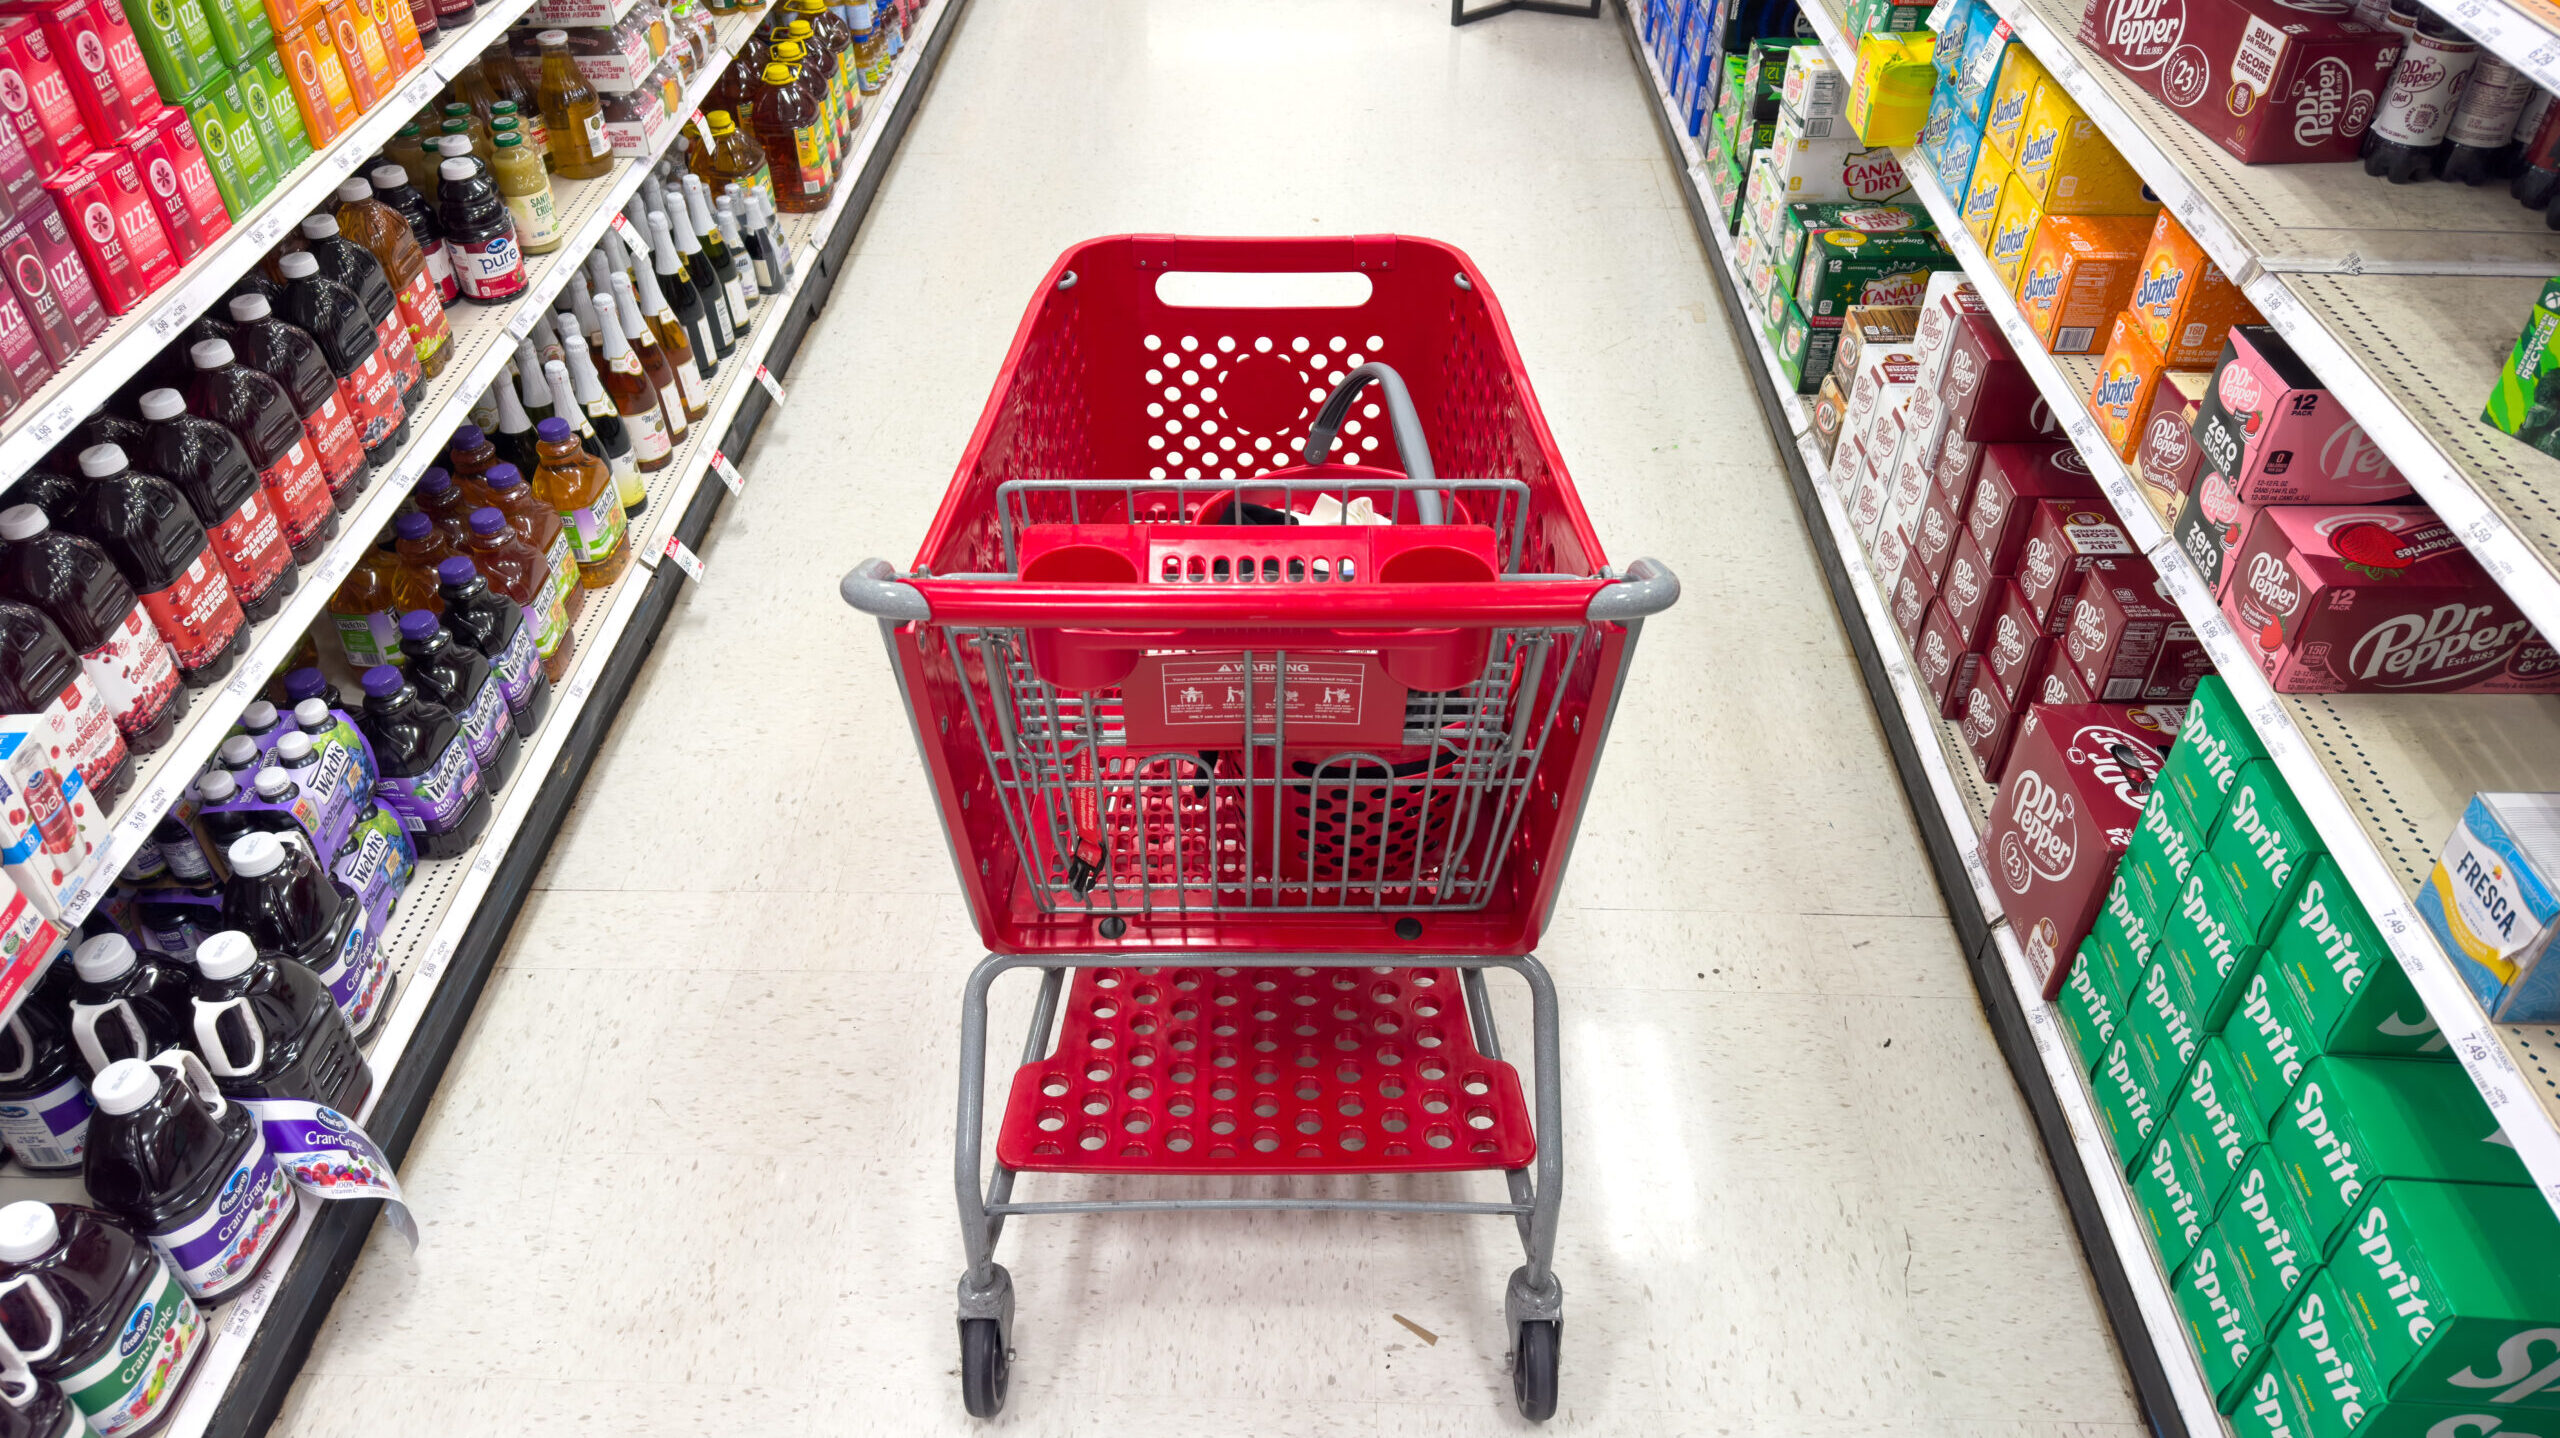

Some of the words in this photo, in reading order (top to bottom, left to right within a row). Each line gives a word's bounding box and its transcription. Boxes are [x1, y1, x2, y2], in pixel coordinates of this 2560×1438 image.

[2457, 1, 2480, 18] 6.29
[1936, 22, 1967, 56] Sunkist
[2108, 0, 2179, 56] Pepper
[2254, 27, 2275, 45] BUY
[110, 34, 141, 72] IZZE
[2246, 34, 2254, 44] DR
[2254, 39, 2276, 57] PEPPER
[2375, 48, 2393, 71] 12
[2528, 48, 2554, 66] 6.29
[320, 54, 342, 83] IZZE
[2174, 60, 2195, 92] 23
[2236, 60, 2267, 84] REWARDS
[2240, 50, 2271, 75] SCORE
[32, 71, 69, 110] IZZE
[272, 86, 296, 119] IZZE
[2393, 93, 2407, 102] Diet
[1926, 108, 1953, 141] Sunkist
[1992, 91, 2027, 127] Sunkist
[2348, 106, 2367, 123] 23
[131, 128, 159, 151] STRAWBERRY
[231, 119, 256, 154] IZZE
[2021, 130, 2058, 166] Sunkist
[116, 161, 135, 179] FIZZY
[181, 156, 211, 195] IZZE
[1942, 144, 1971, 177] Sunkist
[64, 171, 97, 196] STRAWBERRY
[121, 170, 137, 185] FRUIT
[126, 177, 139, 192] JUICE
[1865, 173, 1902, 194] DRY
[165, 194, 184, 215] IZZE
[1968, 184, 1999, 215] Sunkist
[2180, 204, 2194, 217] 3.99
[43, 210, 60, 229] FIZZY
[120, 200, 155, 239] IZZE
[1842, 210, 1914, 226] CANADA
[1867, 218, 1900, 229] DRY
[101, 239, 123, 261] IZZE
[1994, 223, 2029, 257] Sunkist
[51, 250, 84, 292] IZZE
[477, 247, 518, 274] pure
[1829, 260, 1842, 269] 12
[2024, 269, 2062, 302] Sunkist
[2137, 267, 2183, 308] Sunkist
[34, 294, 56, 315] IZZE
[421, 294, 440, 319] WHITE
[2153, 306, 2172, 318] Orange
[2263, 293, 2281, 312] 3.99
[155, 320, 169, 336] 4.99
[391, 333, 411, 360] GRAPE
[2516, 333, 2537, 376] REFRESH
[2535, 313, 2550, 334] THEN
[2521, 316, 2559, 381] RECYCLE
[1961, 355, 1973, 371] Dr
[369, 375, 394, 406] GRAPE
[2096, 371, 2141, 408] Sunkist
[2220, 364, 2258, 402] Pepper
[2236, 371, 2253, 388] Dr
[2112, 406, 2129, 418] Orange
[2293, 394, 2318, 410] 12
[2151, 419, 2184, 457] Pepper
[2167, 421, 2180, 440] Dr
[2207, 415, 2237, 462] zero
[2152, 453, 2159, 467] &
[2203, 432, 2231, 478] SUGAR
[2276, 453, 2284, 464] 0
[397, 475, 410, 489] 3.19
[1985, 483, 1999, 502] Dr
[2110, 480, 2124, 498] 6.99
[2144, 465, 2162, 484] Cream
[2161, 474, 2176, 492] Soda
[1977, 479, 2001, 520] Pepper
[2166, 503, 2176, 517] 12
[2202, 475, 2236, 516] Pepper
[251, 529, 278, 560] BLEND
[2188, 521, 2217, 567] zero
[2468, 521, 2492, 543] 4.59
[2027, 538, 2056, 578] Pepper
[2036, 543, 2051, 561] Dr
[2161, 555, 2177, 572] 6.99
[2185, 538, 2211, 581] SUGAR
[2249, 552, 2296, 607] Pepper
[2269, 561, 2289, 584] Dr
[200, 590, 228, 624] BLEND
[2329, 589, 2356, 604] 12
[2008, 621, 2021, 638] Dr
[2075, 600, 2106, 645] Pepper
[2085, 611, 2103, 630] Dr
[2202, 620, 2218, 639] 6.99
[2243, 603, 2273, 626] Strawberries
[2423, 603, 2493, 641] Dr
[1999, 615, 2024, 656] Pepper
[2071, 639, 2081, 656] 23
[2360, 615, 2526, 680] Pepper
[503, 634, 530, 681] Welch's
[2264, 654, 2275, 675] 12
[2447, 651, 2495, 667] Est.1885
[2087, 668, 2096, 688] 12
[467, 687, 496, 737] Welch's
[1968, 688, 1995, 729] Pepper
[1978, 693, 1992, 711] Dr
[2254, 704, 2273, 727] 7.49
[2026, 709, 2038, 728] 24
[2183, 698, 2236, 795] Sprite
[315, 745, 345, 797] Welch's
[428, 745, 462, 800] Welch's
[30, 786, 63, 822] Diet
[2012, 770, 2070, 862] Pepper
[2039, 785, 2064, 830] Dr
[130, 811, 146, 829] 3.19
[2146, 790, 2190, 884] Sprite
[2232, 785, 2292, 889] Sprite
[354, 832, 384, 885] Welch's
[479, 860, 492, 873] 5.29
[1968, 850, 1980, 870] 12.59
[2006, 847, 2021, 876] 23
[2038, 851, 2057, 871] Est.1885
[70, 889, 91, 911] 3.99
[2457, 851, 2516, 939] FRESCA
[2108, 875, 2151, 969] Sprite
[2183, 875, 2236, 978] Sprite
[2298, 879, 2366, 995] Sprite
[2383, 908, 2407, 935] 7.49
[425, 963, 437, 977] 5.59
[2297, 961, 2316, 993] LEMON-LIME
[2410, 955, 2425, 971] +CRV
[2070, 951, 2115, 1044] Sprite
[2145, 962, 2196, 1066] Sprite
[2243, 974, 2303, 1088] Sprite
[2461, 1031, 2487, 1062] 7.49
[2107, 1039, 2154, 1140] Sprite
[2493, 1086, 2510, 1108] +CRV
[2191, 1060, 2245, 1172] Sprite
[2296, 1082, 2363, 1206] Sprite
[221, 1193, 238, 1211] Ocean
[235, 1173, 248, 1198] Spray
[2151, 1138, 2201, 1249] Sprite
[2295, 1163, 2313, 1198] LEMON-LIME
[2240, 1168, 2300, 1292] Sprite
[2358, 1206, 2436, 1346] Sprite
[252, 1283, 265, 1303] +CRV
[2193, 1247, 2250, 1369] Sprite
[2357, 1291, 2378, 1331] LEMON-LIME
[122, 1333, 140, 1353] Ocean
[136, 1309, 152, 1336] Spray
[2297, 1293, 2367, 1430] Sprite
[2296, 1374, 2315, 1412] LEMON-LIME
